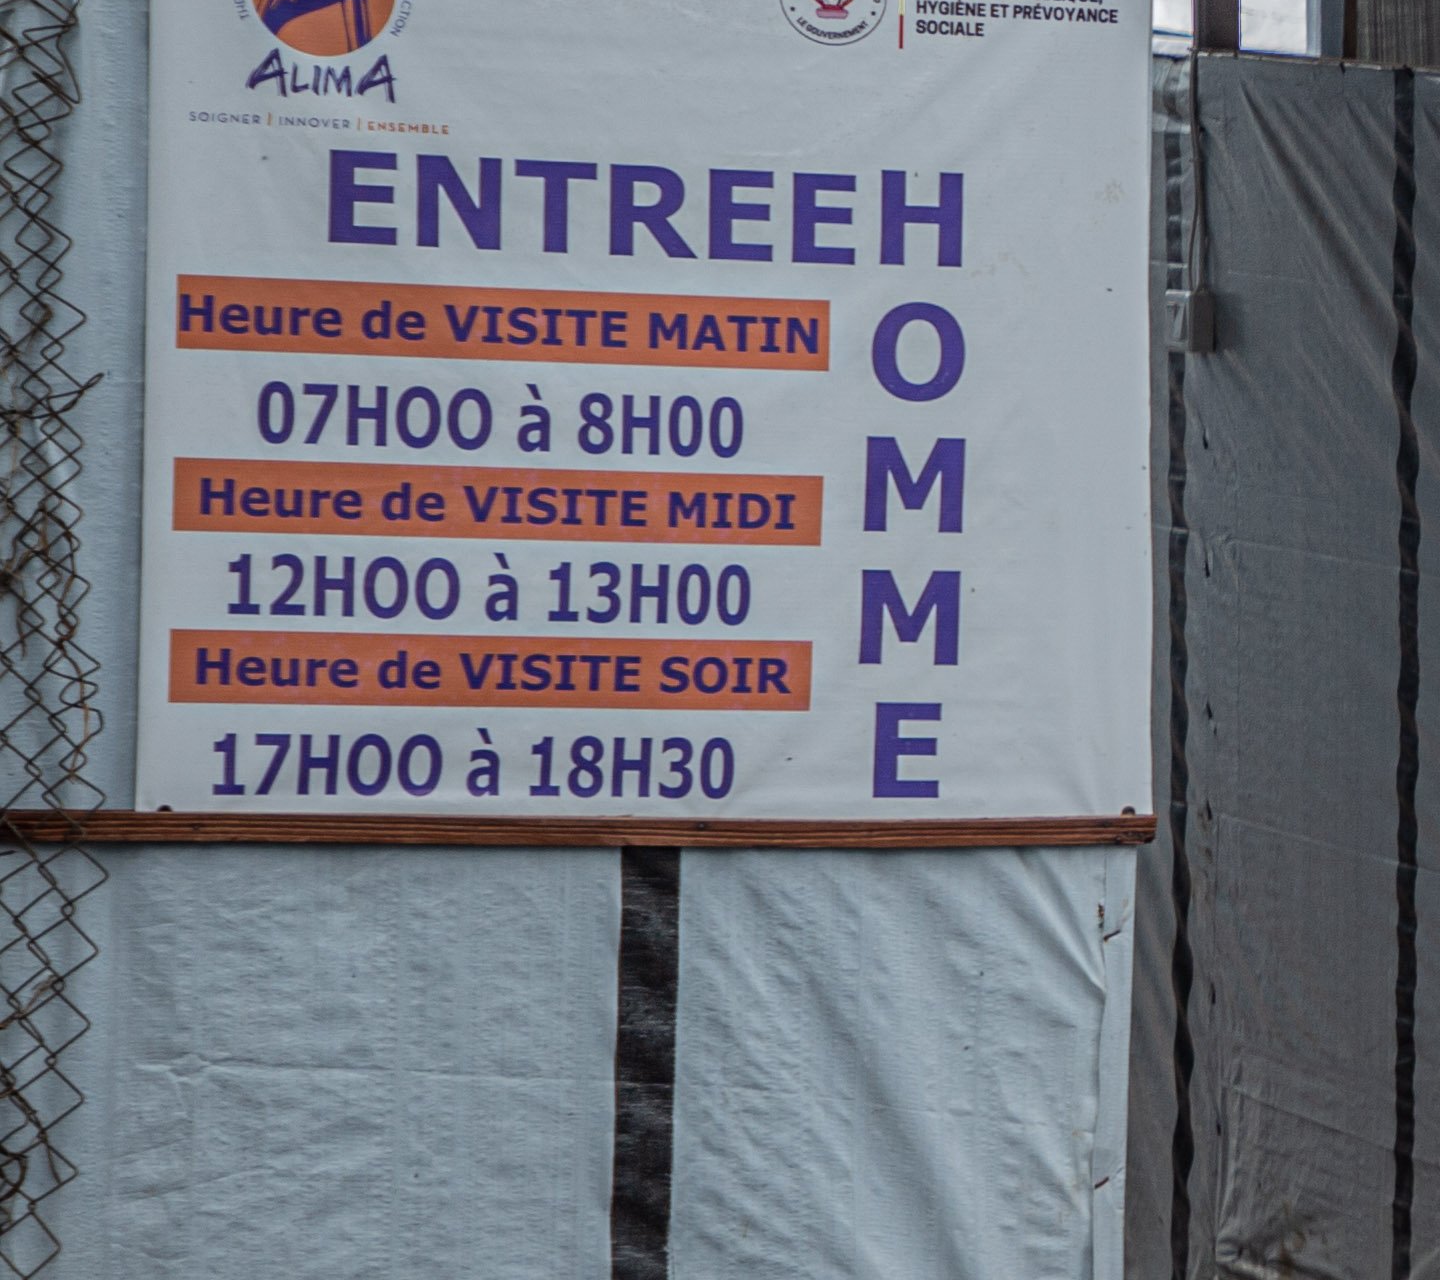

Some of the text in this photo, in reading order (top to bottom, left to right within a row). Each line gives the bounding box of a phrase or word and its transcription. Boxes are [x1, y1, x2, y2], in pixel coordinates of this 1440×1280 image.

[915, 19, 985, 37] SOCIALE
[916, 0, 1118, 24] HYGIÈNE ET PRÉVOYANCE
[245, 48, 397, 104] ALIMA
[188, 110, 450, 136] SOIGNER INNOVER ENSEMBLE
[328, 148, 857, 266] ENTREE
[178, 293, 820, 355] Heure de VISITE MATIN
[516, 383, 552, 454] à
[199, 476, 797, 531] Heure de VISITE MIDI
[858, 169, 967, 799] HOMME
[484, 552, 520, 622] à
[195, 647, 792, 695] Heure de VISITE SOIR
[465, 727, 501, 798] à
[528, 735, 736, 800] 18H30
